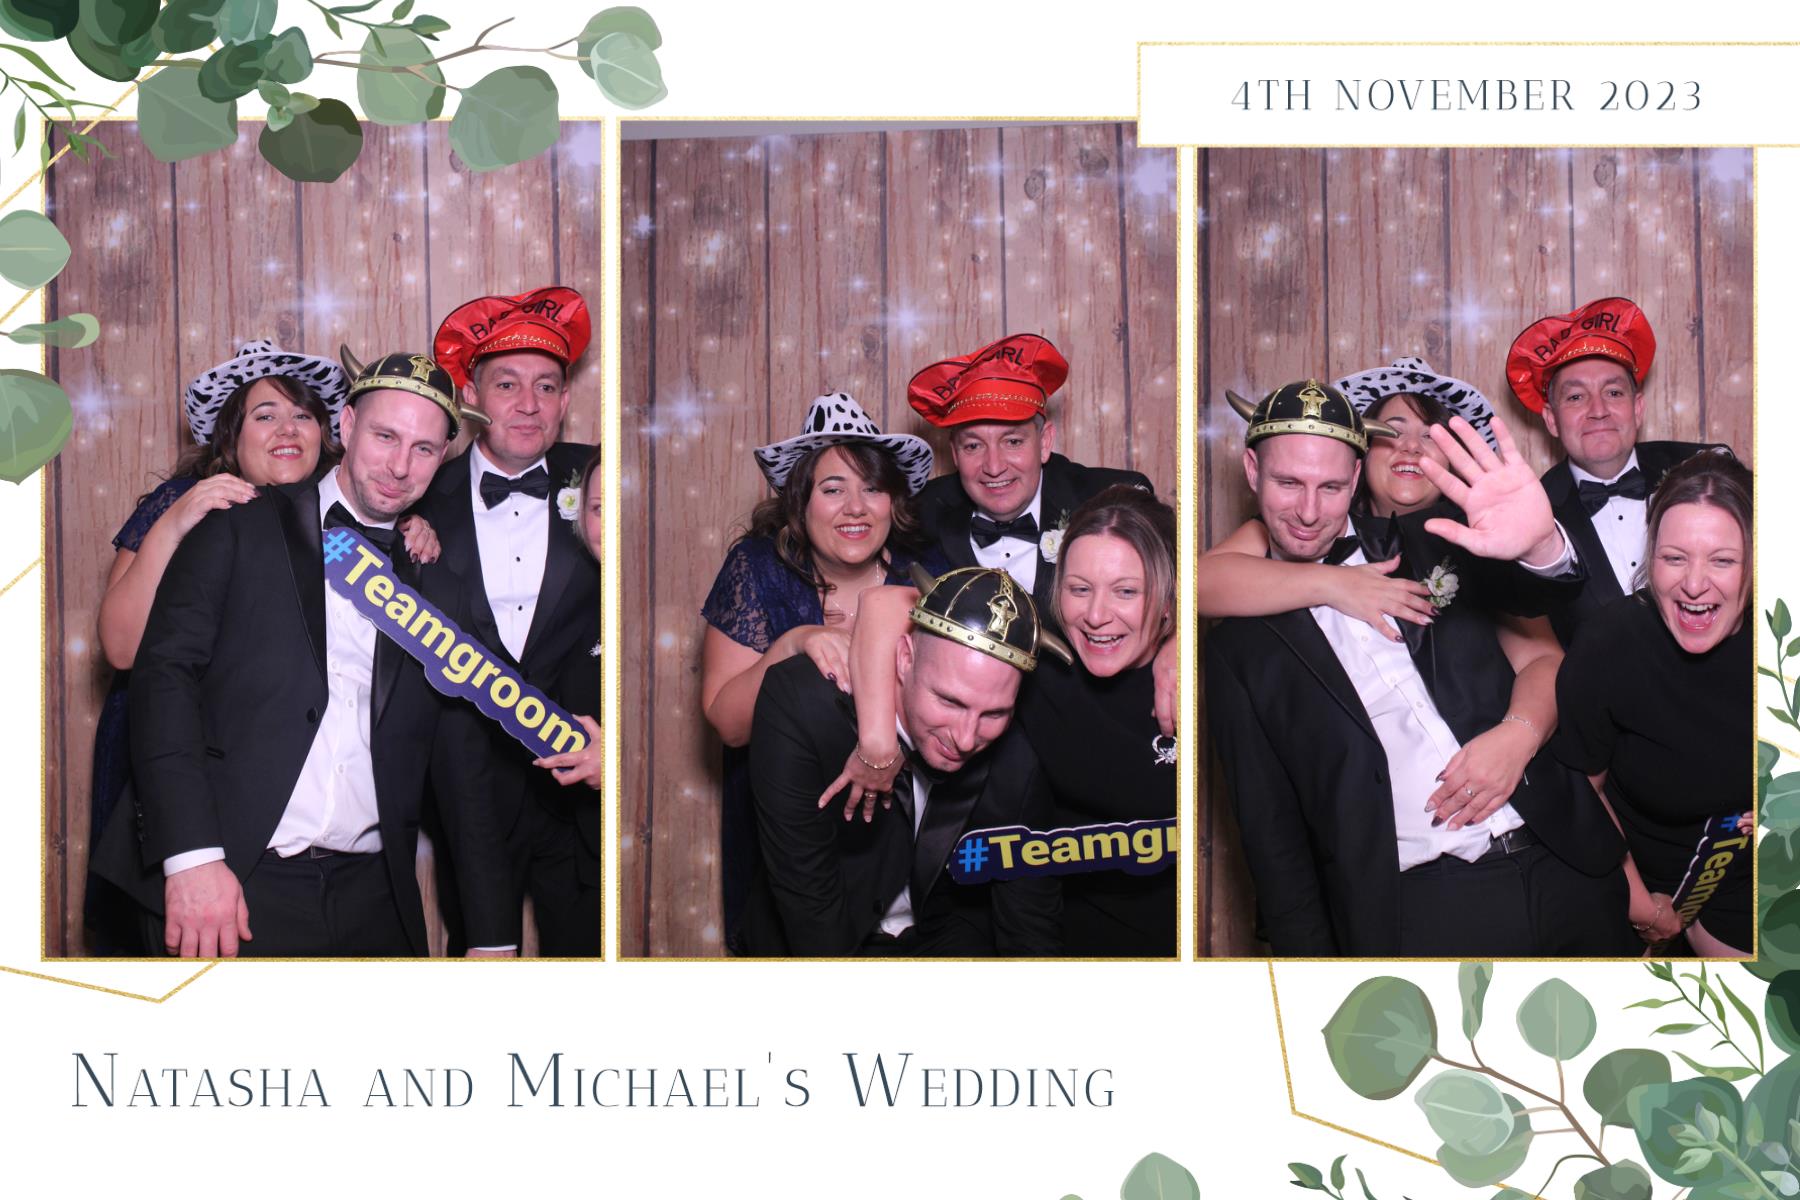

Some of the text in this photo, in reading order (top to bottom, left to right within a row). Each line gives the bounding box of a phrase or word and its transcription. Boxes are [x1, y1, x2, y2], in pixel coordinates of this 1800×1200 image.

[1534, 312, 1621, 361] BAD GIRL
[323, 530, 586, 754] #Teamgroom
